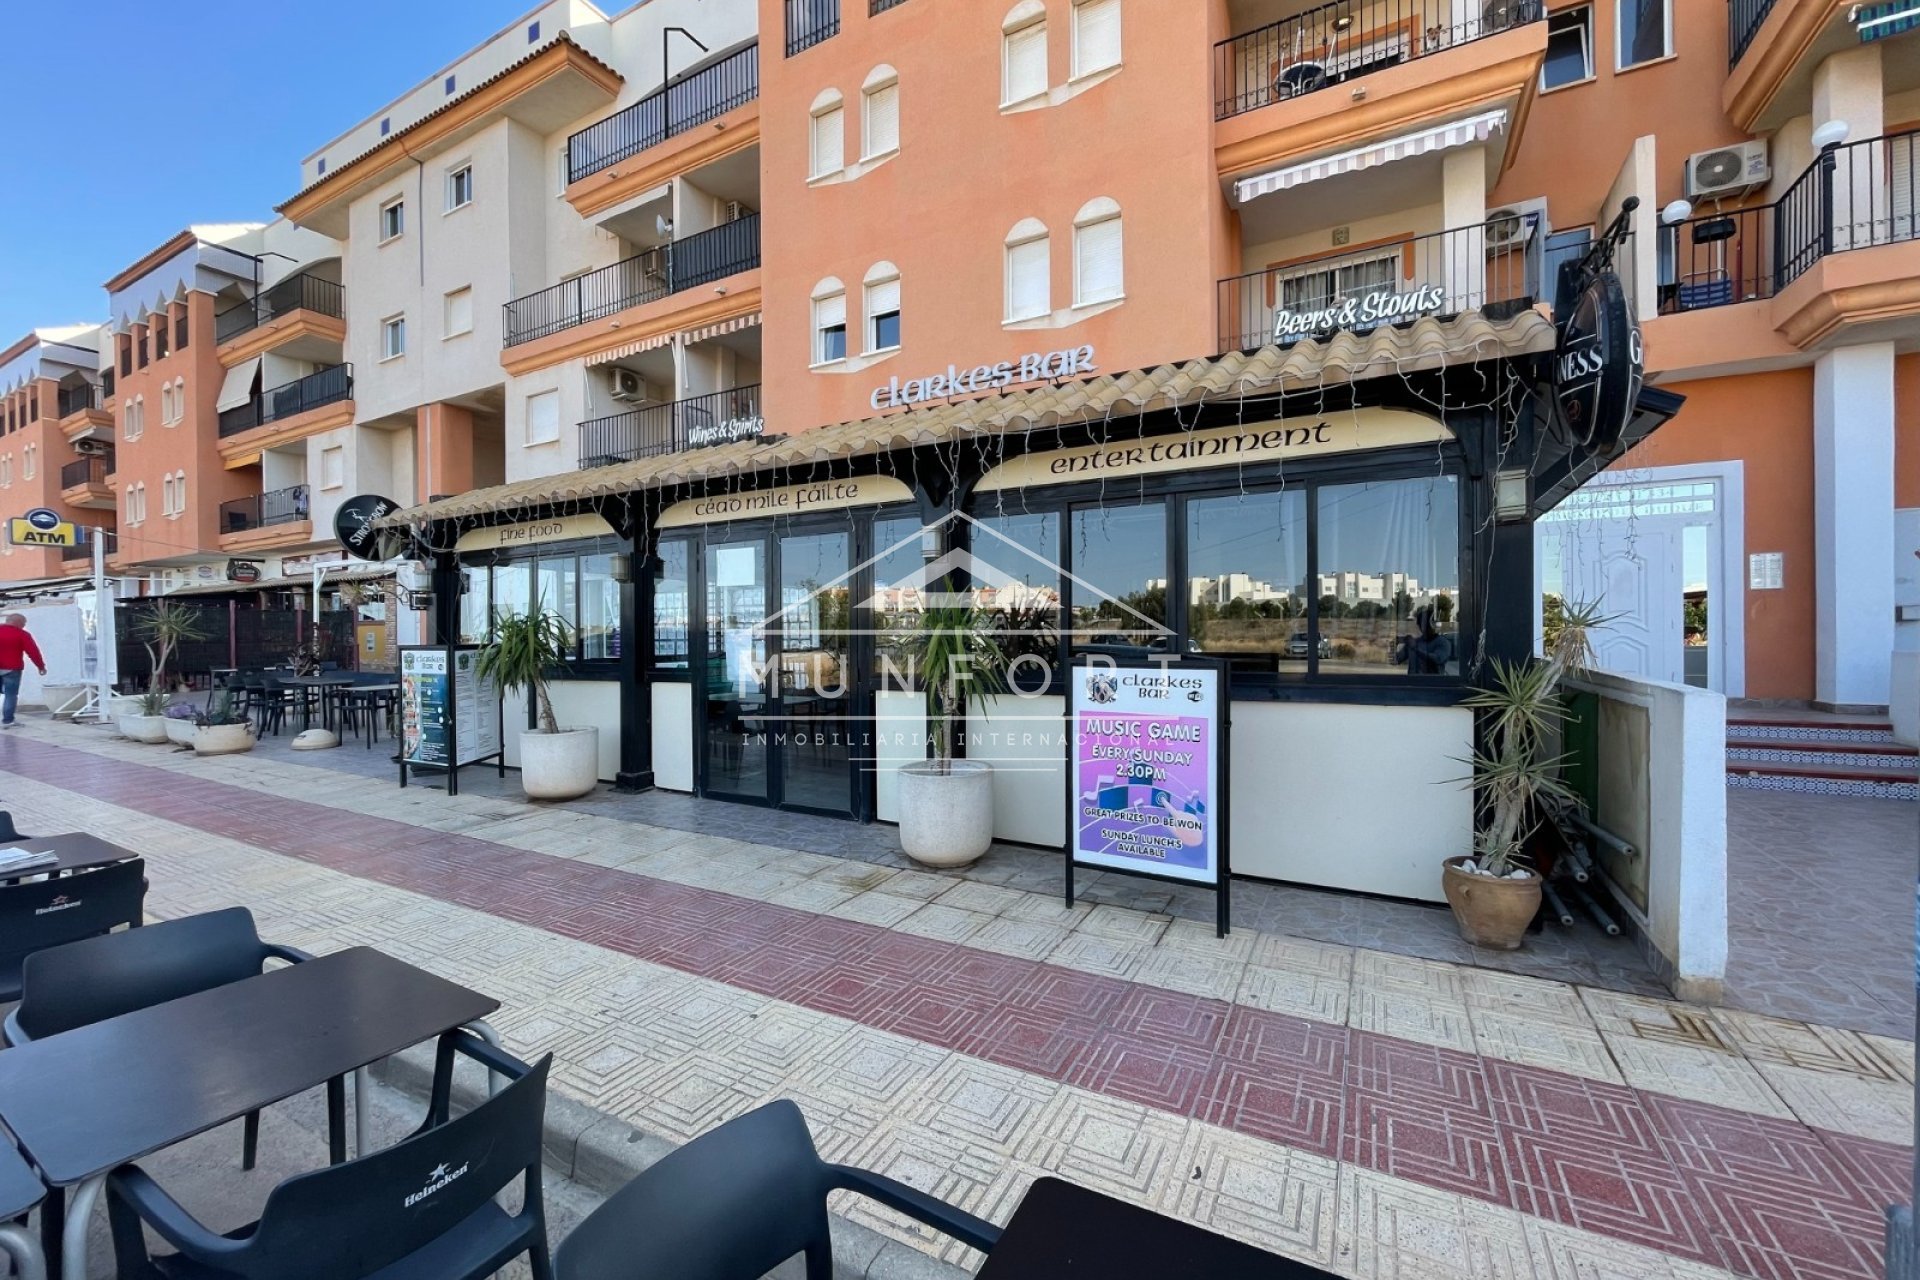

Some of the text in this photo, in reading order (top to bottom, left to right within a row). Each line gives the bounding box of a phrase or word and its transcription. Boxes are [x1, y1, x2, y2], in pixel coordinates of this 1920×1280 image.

[1274, 284, 1443, 337] Beers & Stouts
[688, 416, 764, 444] Wines & Spirits
[1050, 421, 1331, 474] entertainment
[23, 531, 66, 544] ATM
[500, 523, 563, 544] fine food
[1086, 719, 1201, 742] MUSIC GAME
[1092, 745, 1193, 766] EVERY SUNDAY
[1116, 763, 1167, 781] 2.30PM
[1084, 808, 1203, 831] GREAT PRIZES TO BE WON
[1102, 829, 1139, 842] SUNDAY
[1118, 843, 1166, 858] AVAILABLE
[404, 1163, 468, 1208] Heineken
